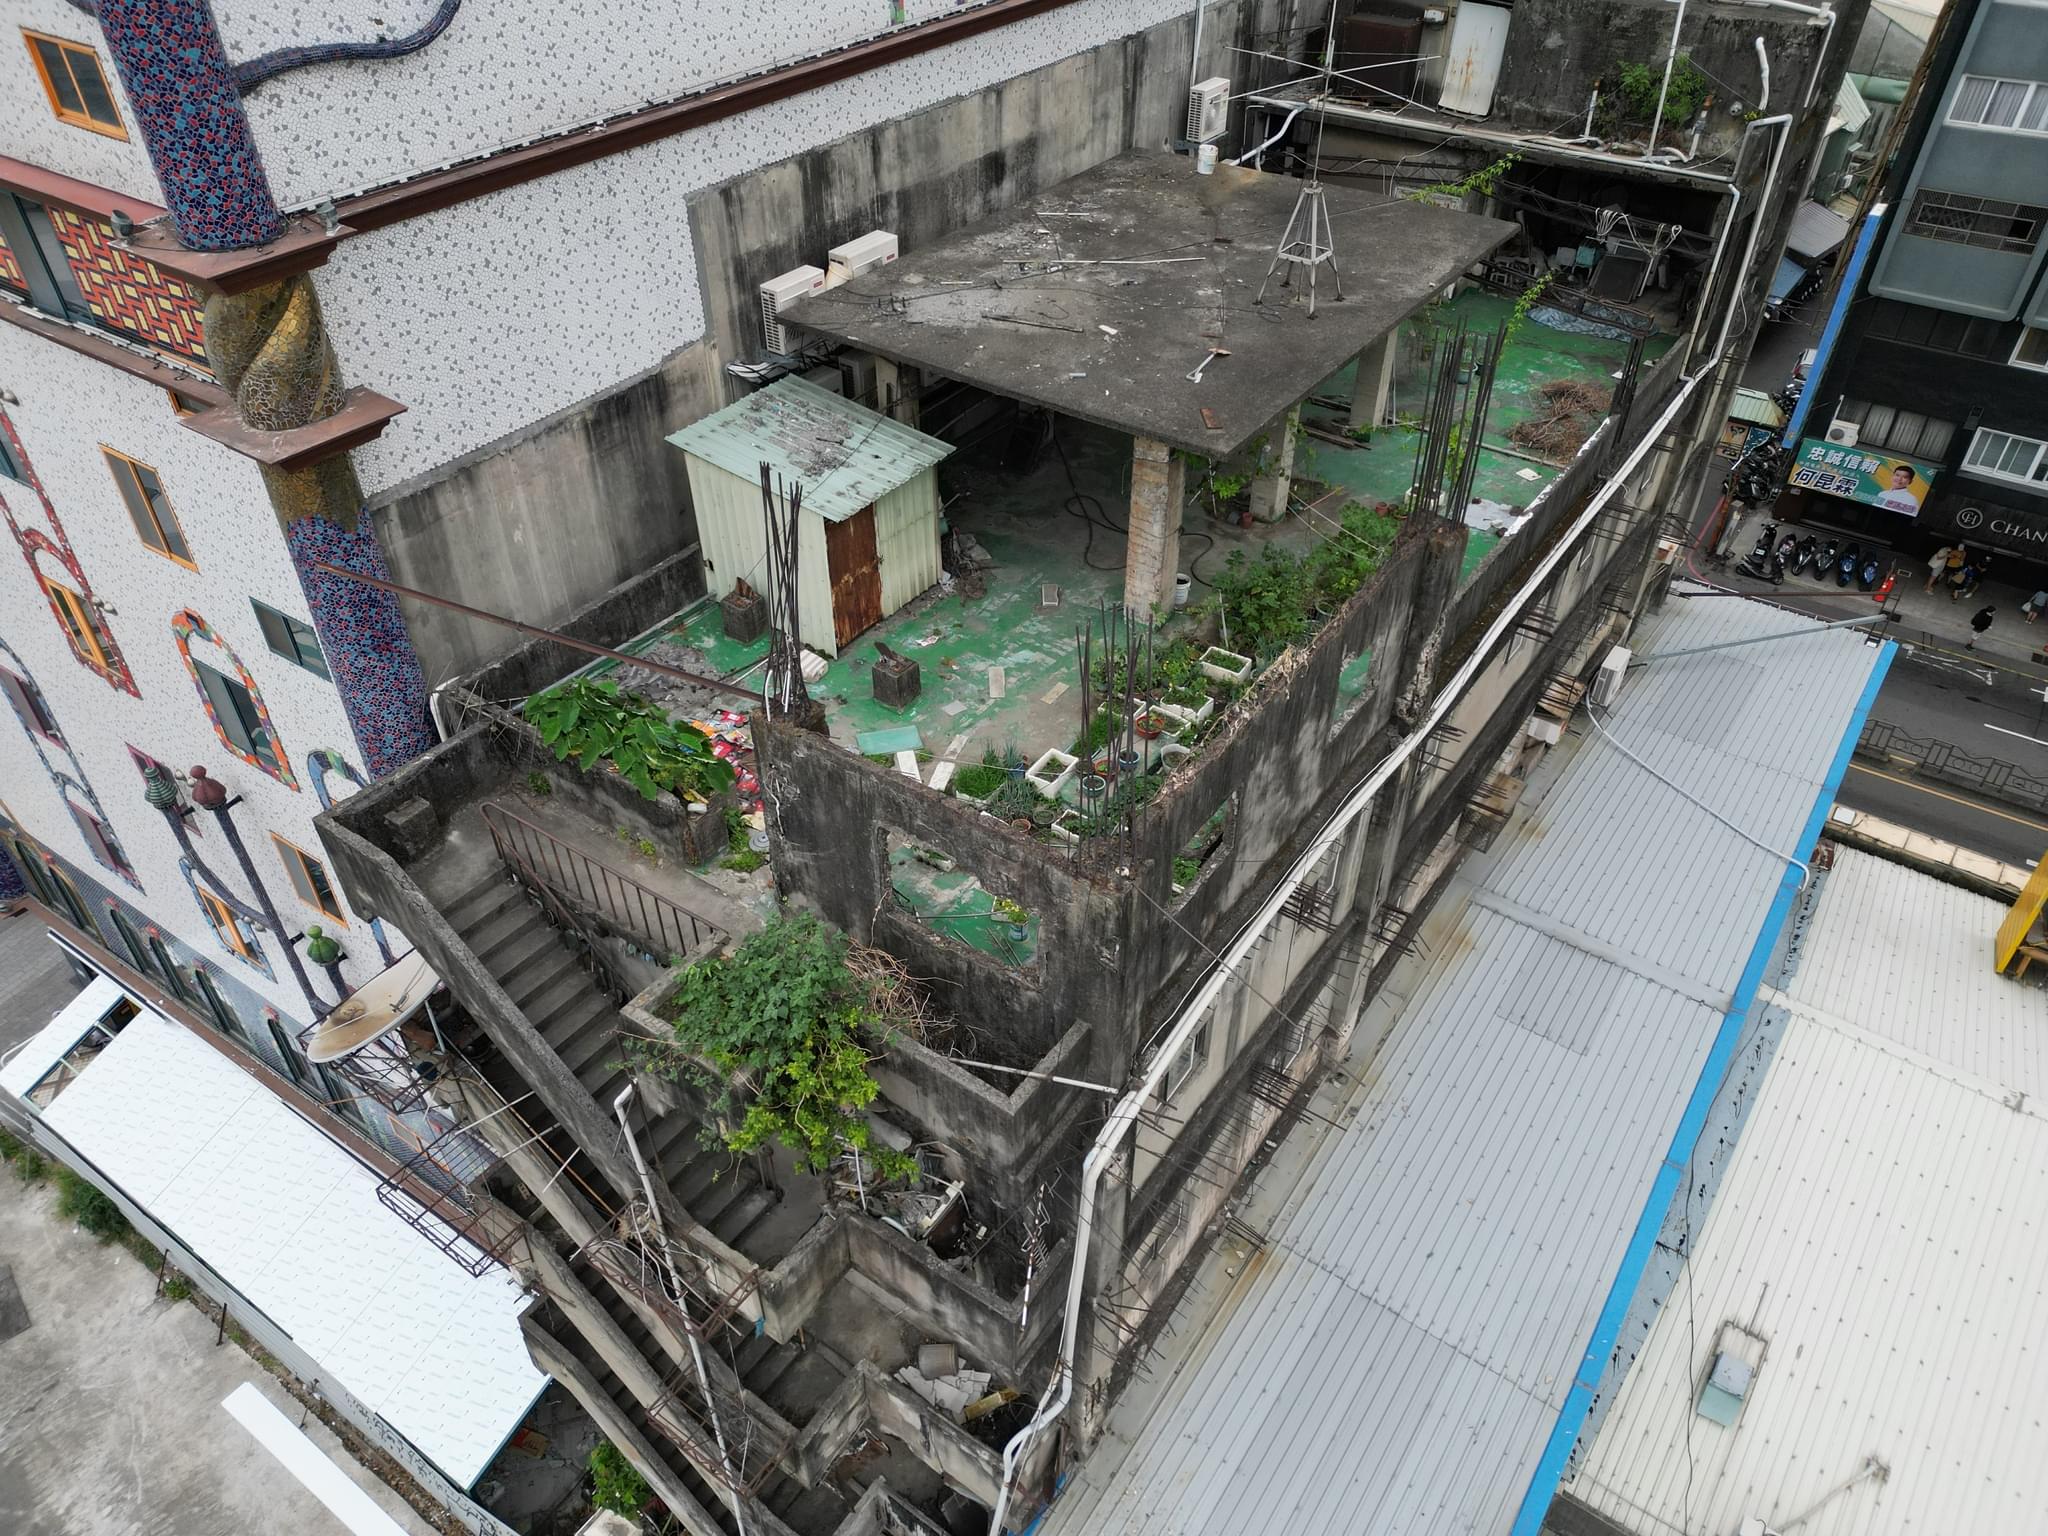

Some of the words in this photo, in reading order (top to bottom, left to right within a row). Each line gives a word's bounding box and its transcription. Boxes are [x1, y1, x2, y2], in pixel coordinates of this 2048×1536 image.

[1807, 446, 1880, 474] 忠誠信賴
[1792, 467, 1859, 496] 何昆霖
